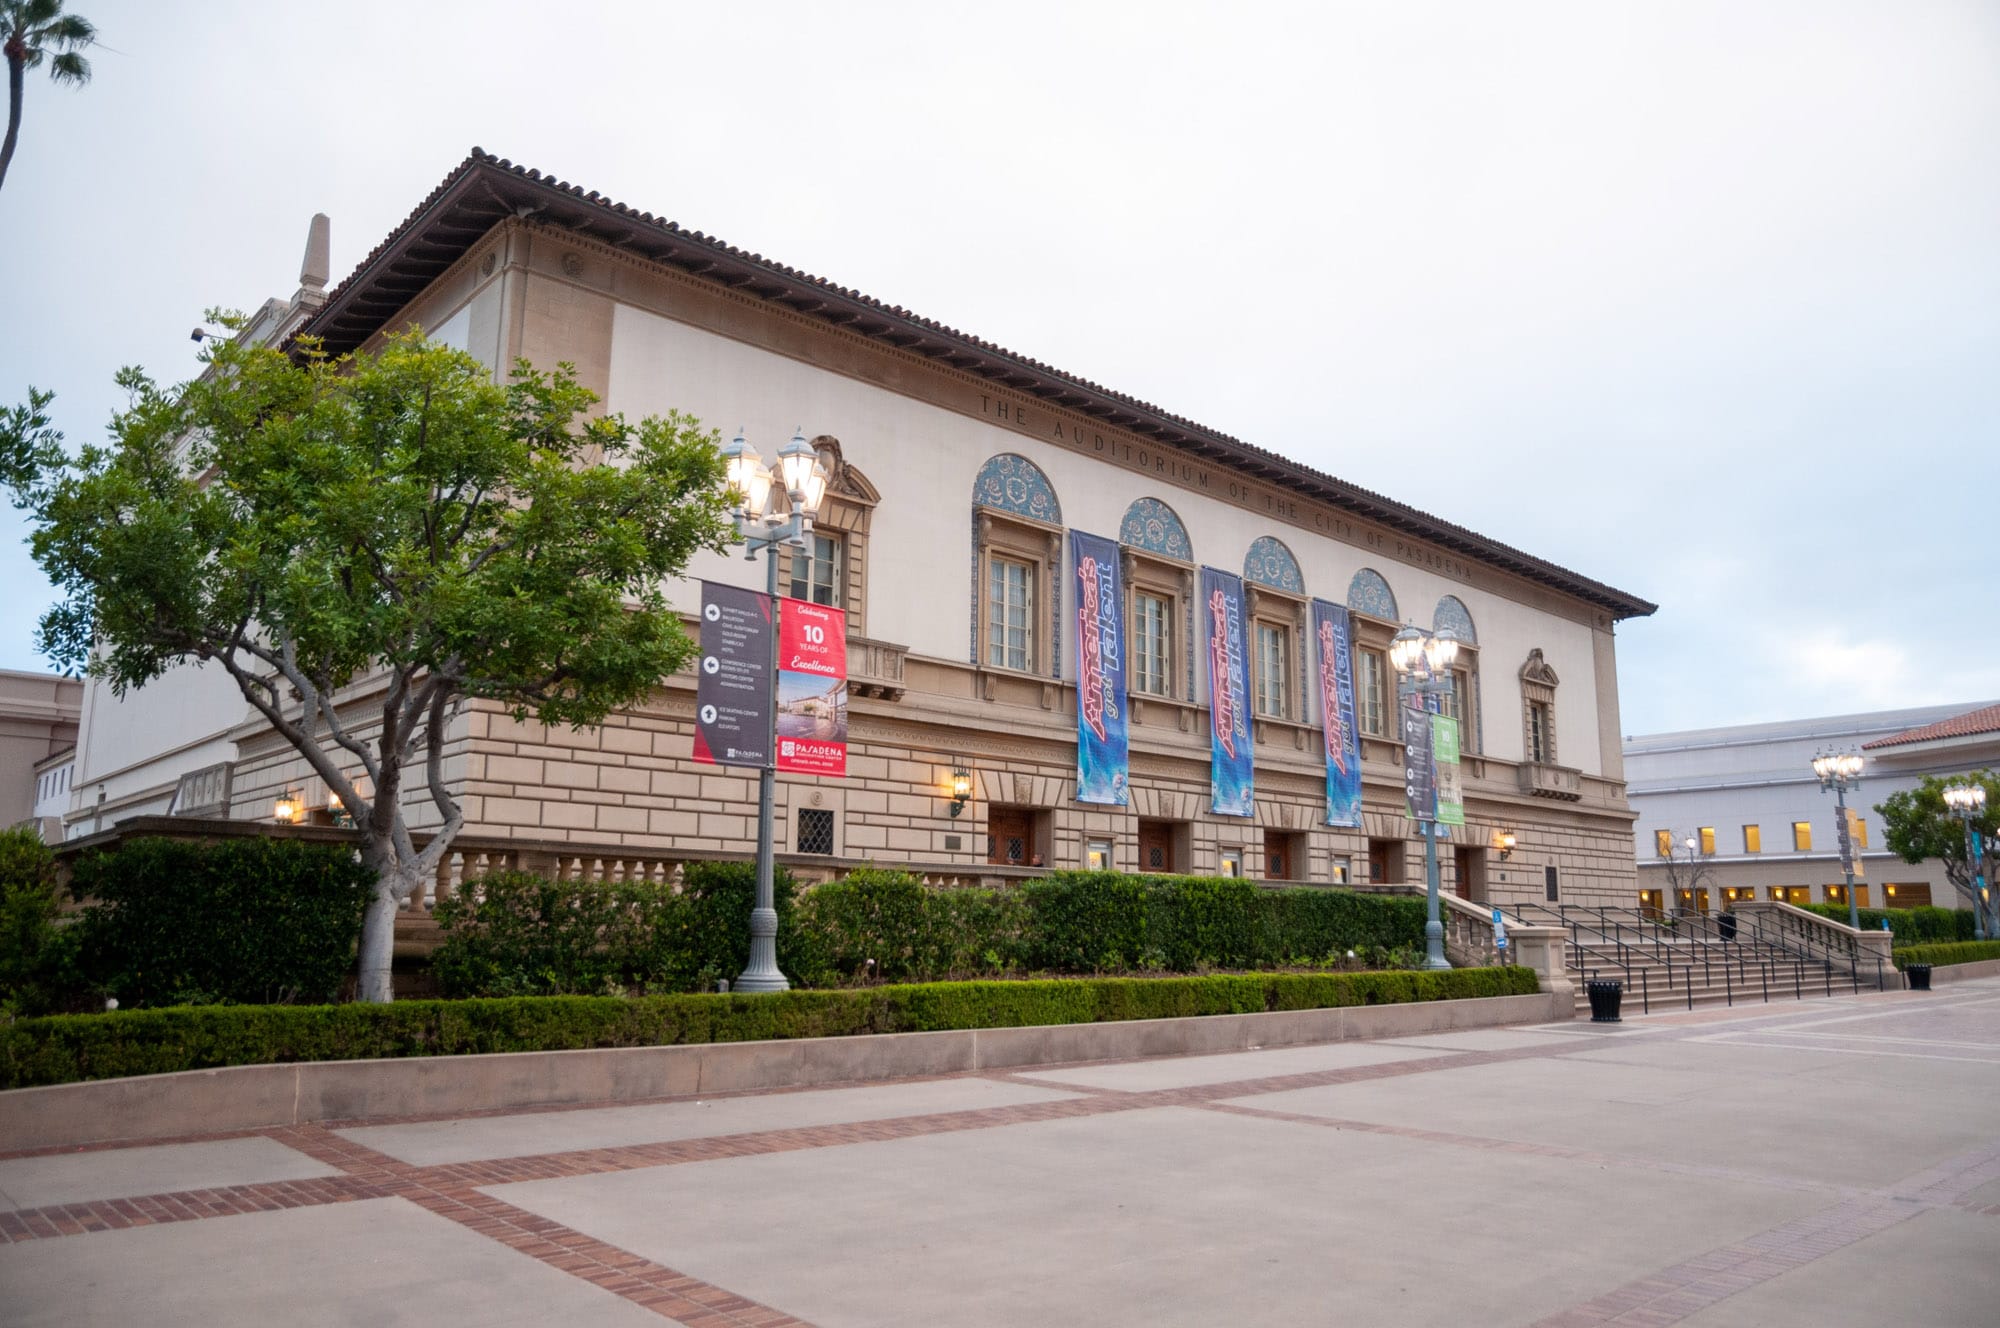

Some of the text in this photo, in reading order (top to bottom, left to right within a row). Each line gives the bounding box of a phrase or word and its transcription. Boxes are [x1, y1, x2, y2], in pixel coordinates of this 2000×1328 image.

[980, 394, 1472, 580] THE AUDITORIUM OF THE CITY OF PASADENA
[799, 642, 819, 652] YEARS
[803, 624, 824, 645] 10
[1096, 562, 1121, 679] Talent
[1224, 594, 1245, 697] Talent
[791, 655, 836, 673] Excellence
[1078, 556, 1106, 743] America's
[1332, 624, 1353, 717] Talent
[735, 750, 763, 758] PASADENA
[796, 744, 842, 757] PASADENA
